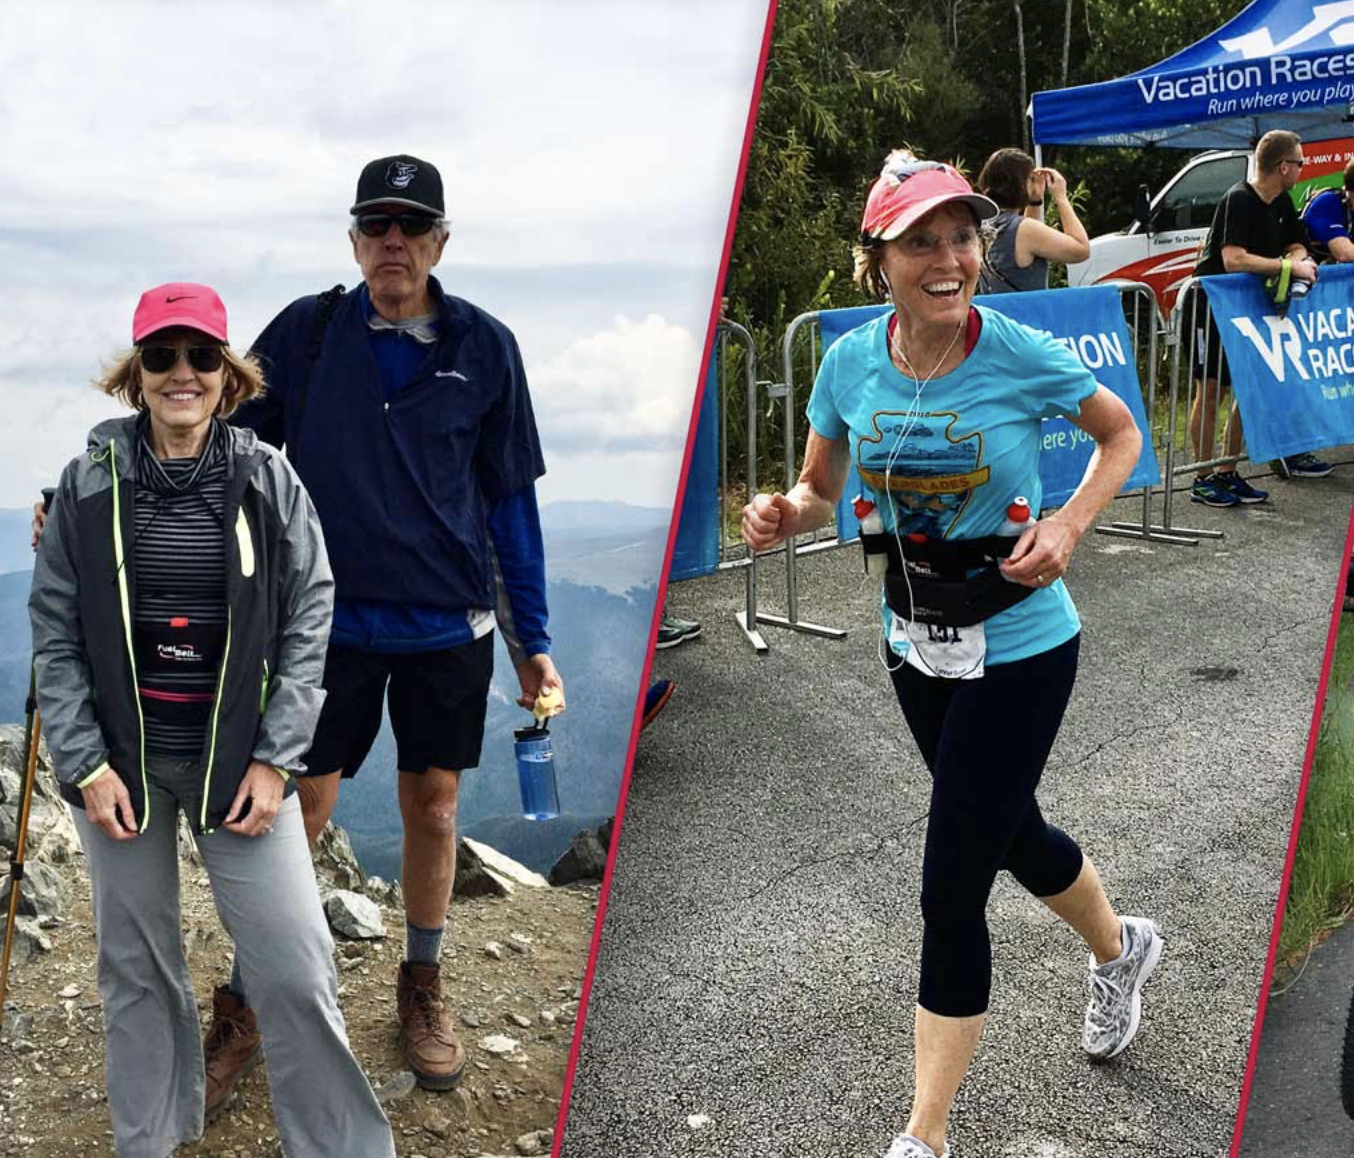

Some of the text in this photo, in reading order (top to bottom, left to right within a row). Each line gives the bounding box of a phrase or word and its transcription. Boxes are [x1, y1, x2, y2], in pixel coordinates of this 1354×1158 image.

[1137, 65, 1262, 104] Vacation
[1207, 98, 1236, 115] Run
[1240, 90, 1286, 111] where
[1291, 83, 1320, 108] you
